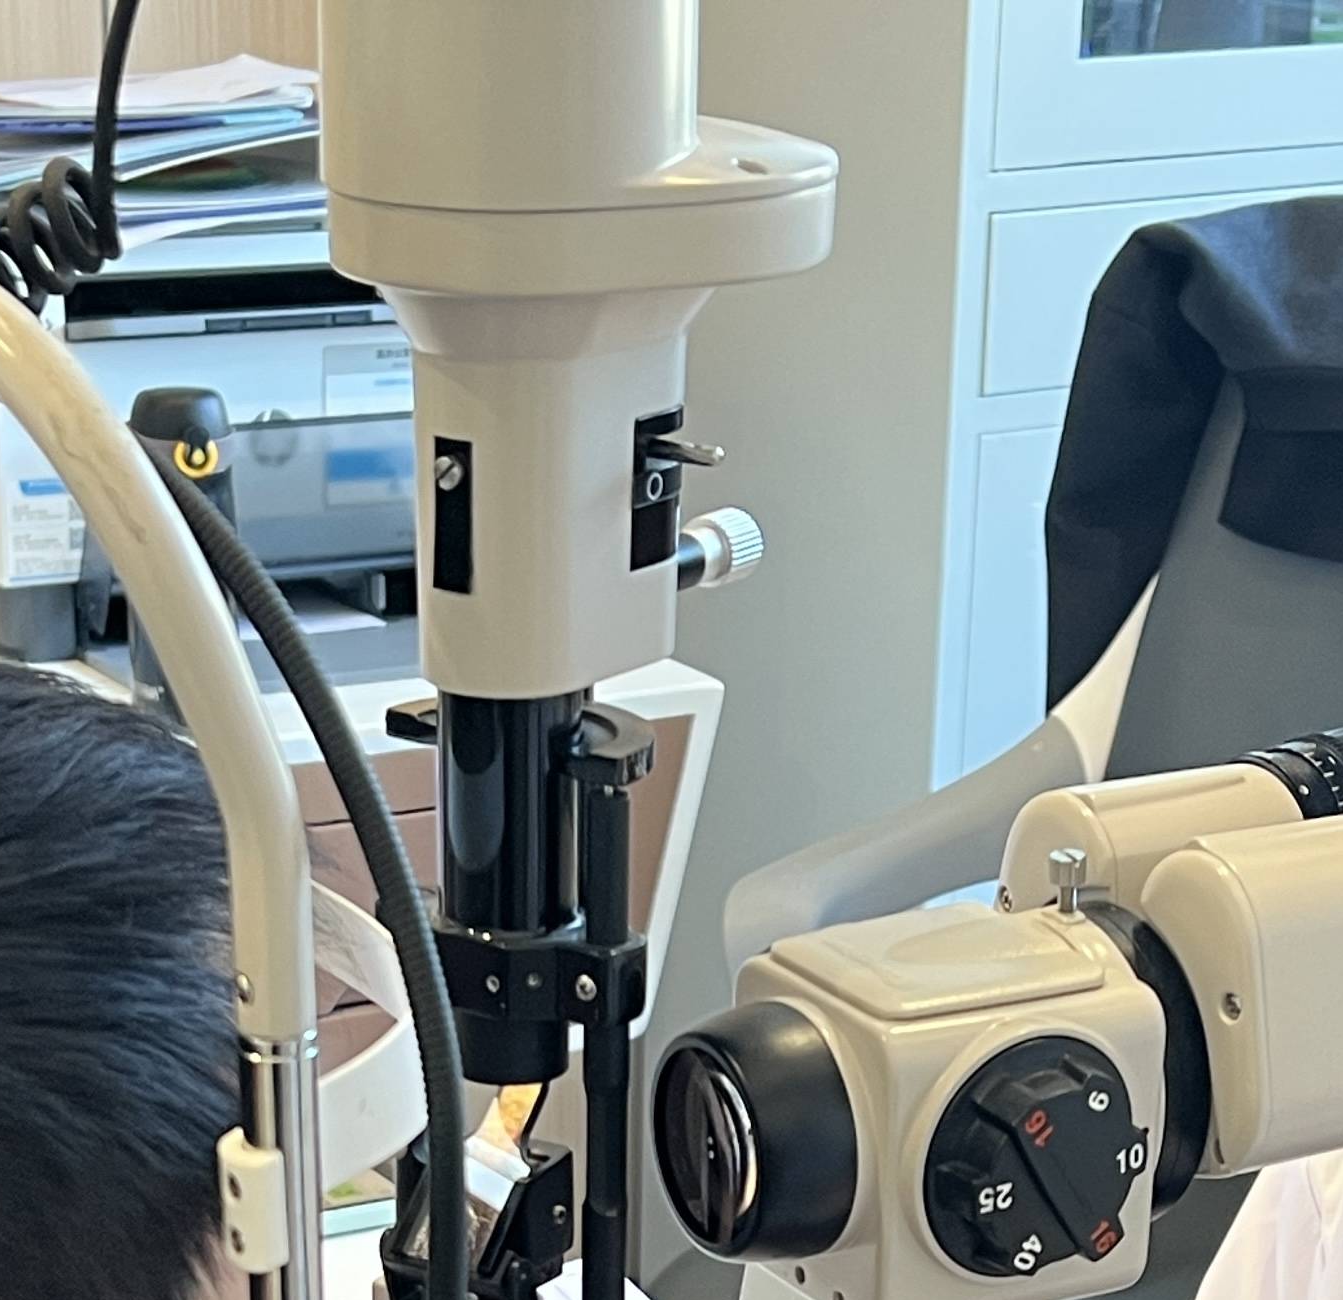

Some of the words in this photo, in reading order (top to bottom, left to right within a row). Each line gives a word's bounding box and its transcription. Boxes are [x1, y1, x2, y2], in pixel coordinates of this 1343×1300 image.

[1025, 1110, 1054, 1147] 16
[1115, 1143, 1144, 1174] 10
[979, 1182, 1013, 1214] 25
[1013, 1233, 1043, 1271] 40
[1091, 1220, 1117, 1253] 16
